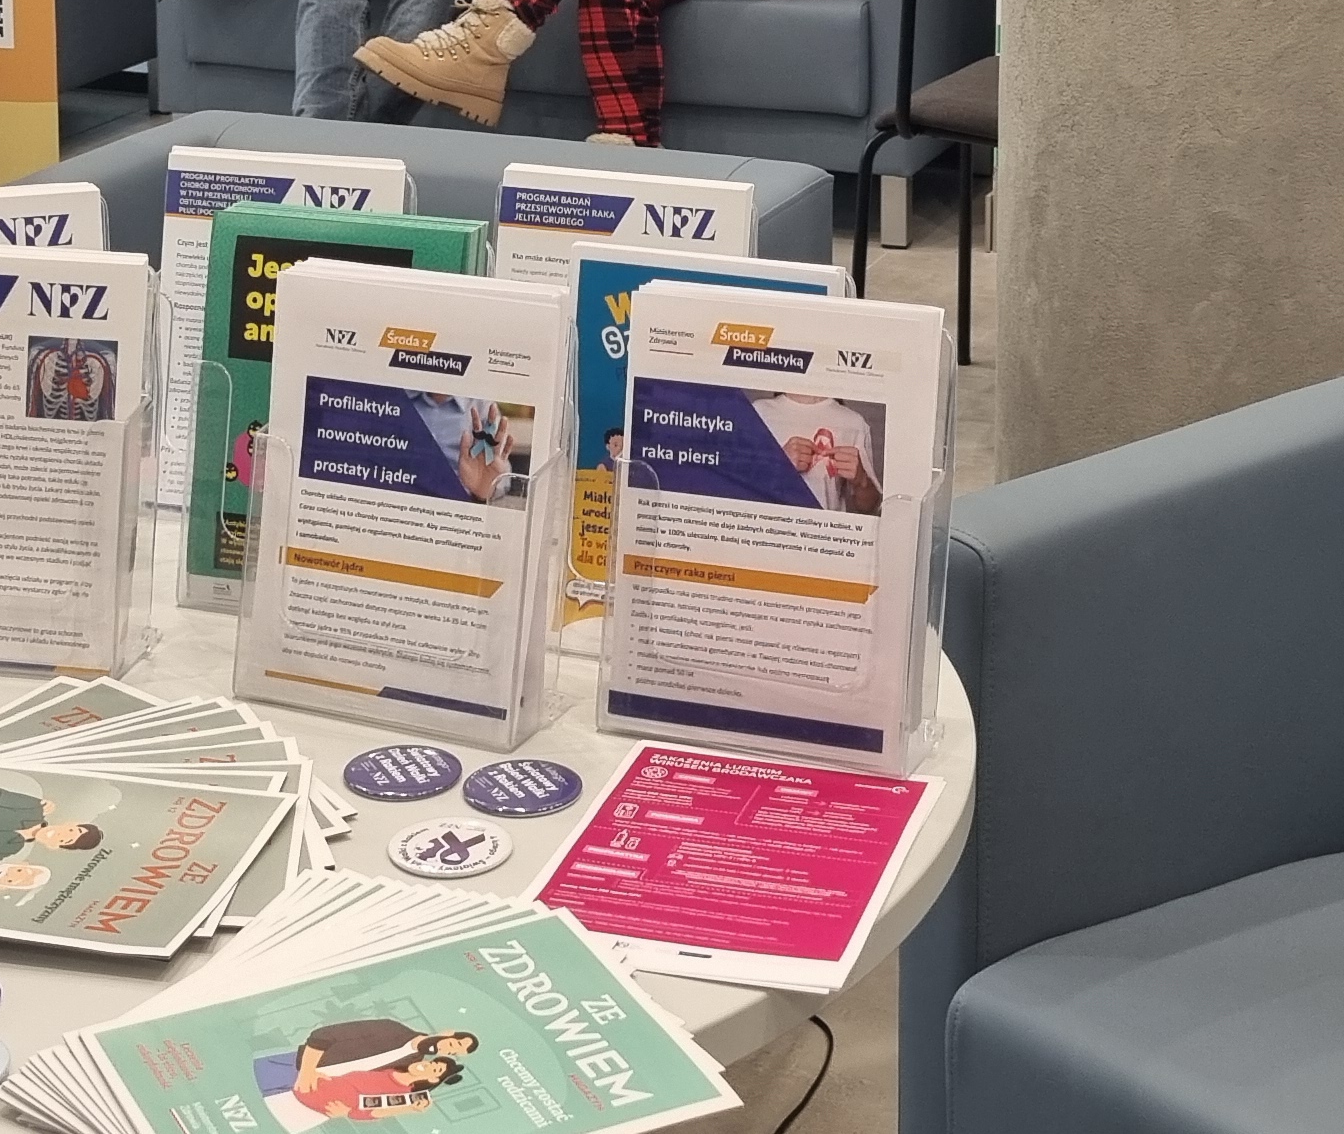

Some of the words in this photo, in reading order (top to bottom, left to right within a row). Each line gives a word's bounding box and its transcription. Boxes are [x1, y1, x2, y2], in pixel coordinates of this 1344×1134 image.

[180, 173, 214, 182] PROGRAM
[216, 175, 266, 185] PROFILAKTYKI
[180, 180, 209, 190] CHORÓB
[302, 184, 372, 211] NFZ
[516, 191, 559, 203] PROGRAM
[560, 195, 591, 207] BADAŃ
[514, 213, 540, 223] JELITA
[542, 215, 584, 227] GRUBEGO
[515, 202, 589, 217] PRZESIEWOWYCH
[591, 209, 615, 219] RAKA
[641, 204, 717, 241] NFZ
[27, 281, 111, 321] NFZ
[325, 327, 357, 346] NFZ
[386, 330, 420, 347] Środa
[421, 338, 429, 348] z
[649, 327, 695, 339] Ministerstwo
[719, 326, 756, 343] Środa
[758, 335, 766, 344] z
[397, 351, 463, 371] Profilaktyką
[732, 348, 804, 369] Profilaktyką
[836, 350, 874, 370] NFZ
[319, 392, 401, 417] Profilaktyka
[643, 408, 734, 433] Profilaktyka
[317, 426, 409, 451] nowotworów
[641, 443, 674, 461] raka
[678, 447, 720, 468] piersi
[313, 459, 370, 482] prostaty
[373, 463, 378, 478] i
[379, 464, 417, 486] jąder
[580, 537, 593, 548] To
[293, 552, 340, 569] Nowotwór
[577, 550, 593, 565] dla
[683, 568, 705, 580] raka
[707, 569, 736, 583] piersi
[649, 757, 710, 773] WIRUSEM
[712, 767, 813, 785] BRODAWCZAKA
[652, 753, 723, 769] ZAKAŻENIA
[724, 763, 783, 775] LUDZKIM
[75, 847, 113, 887] Zdrowie
[83, 796, 228, 935] ZDROWIEM
[178, 860, 220, 887] ZE
[31, 880, 83, 924] mężczyzny
[580, 993, 627, 1026] ZE
[478, 939, 654, 1107] ZDROWIEM
[499, 1048, 536, 1093] Chcemy
[533, 1085, 574, 1123] zostać
[214, 1094, 258, 1133] NFZ
[497, 1075, 553, 1129] rodzicami
